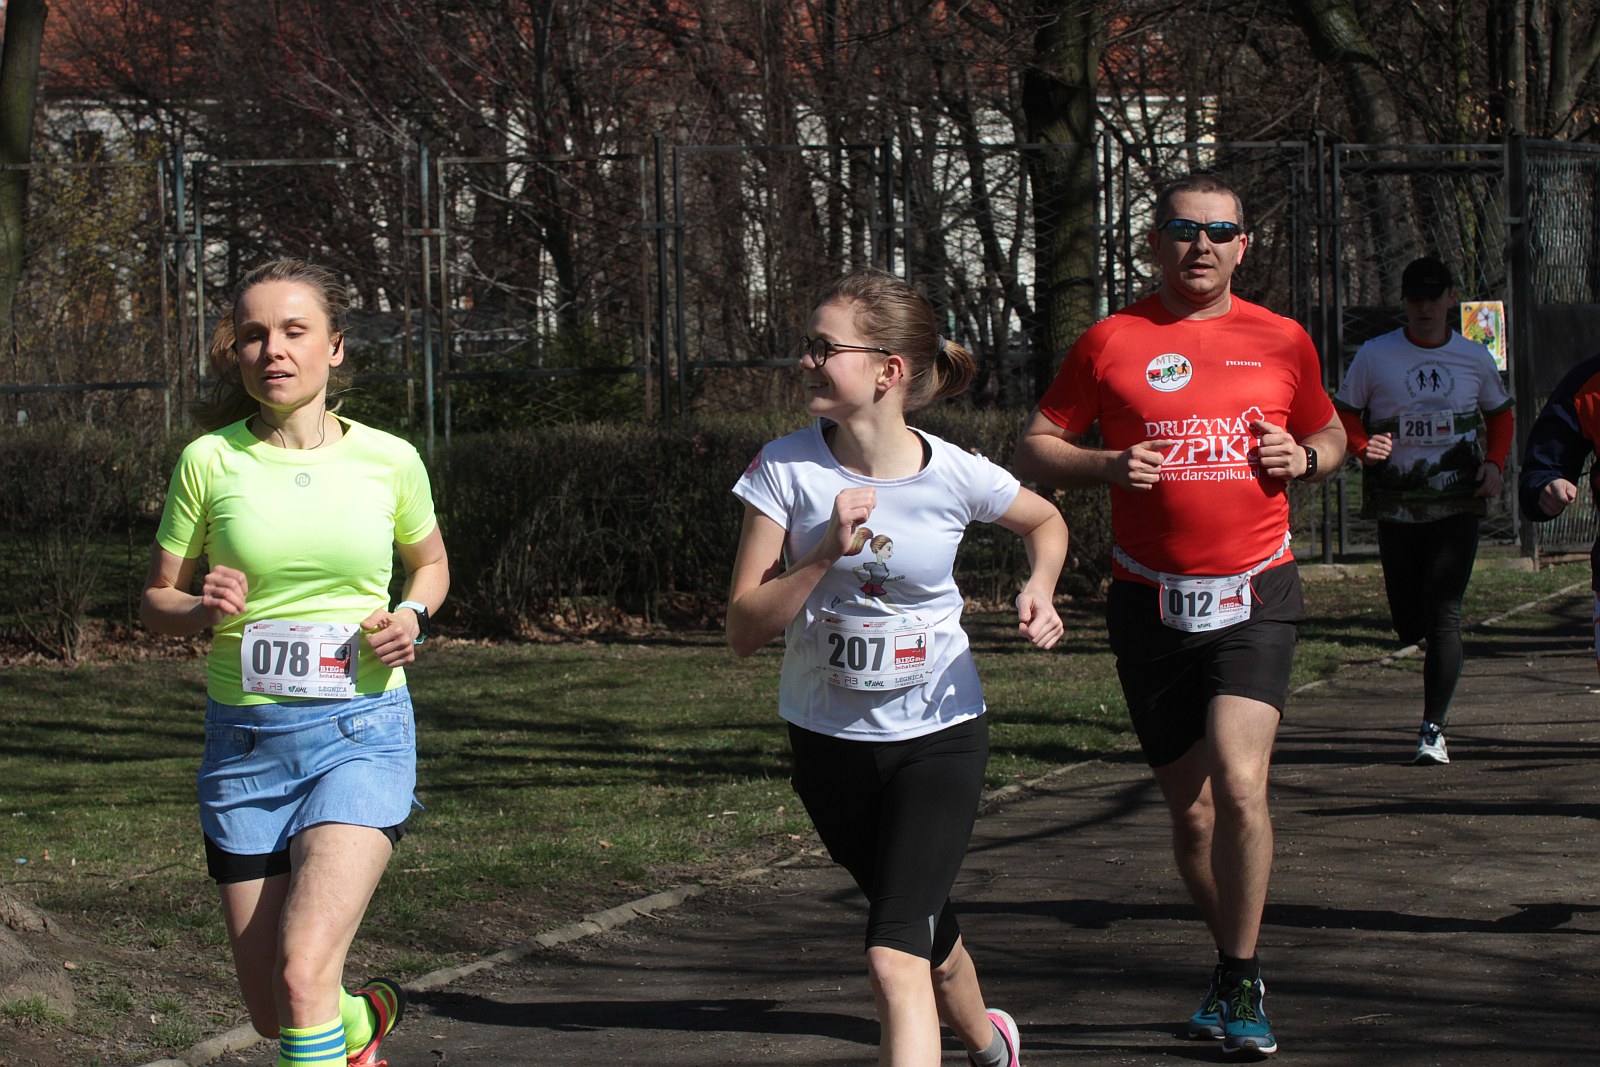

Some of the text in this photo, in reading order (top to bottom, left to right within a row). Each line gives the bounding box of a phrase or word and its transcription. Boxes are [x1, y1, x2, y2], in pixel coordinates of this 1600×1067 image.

[1156, 354, 1181, 366] MTS
[1145, 414, 1246, 438] DRUŻYNA
[1405, 420, 1433, 437] 281
[1168, 589, 1213, 618] 012
[252, 639, 310, 677] 078
[828, 632, 886, 671] 207
[320, 665, 340, 674] BIEG
[895, 674, 924, 684] LEGNICA
